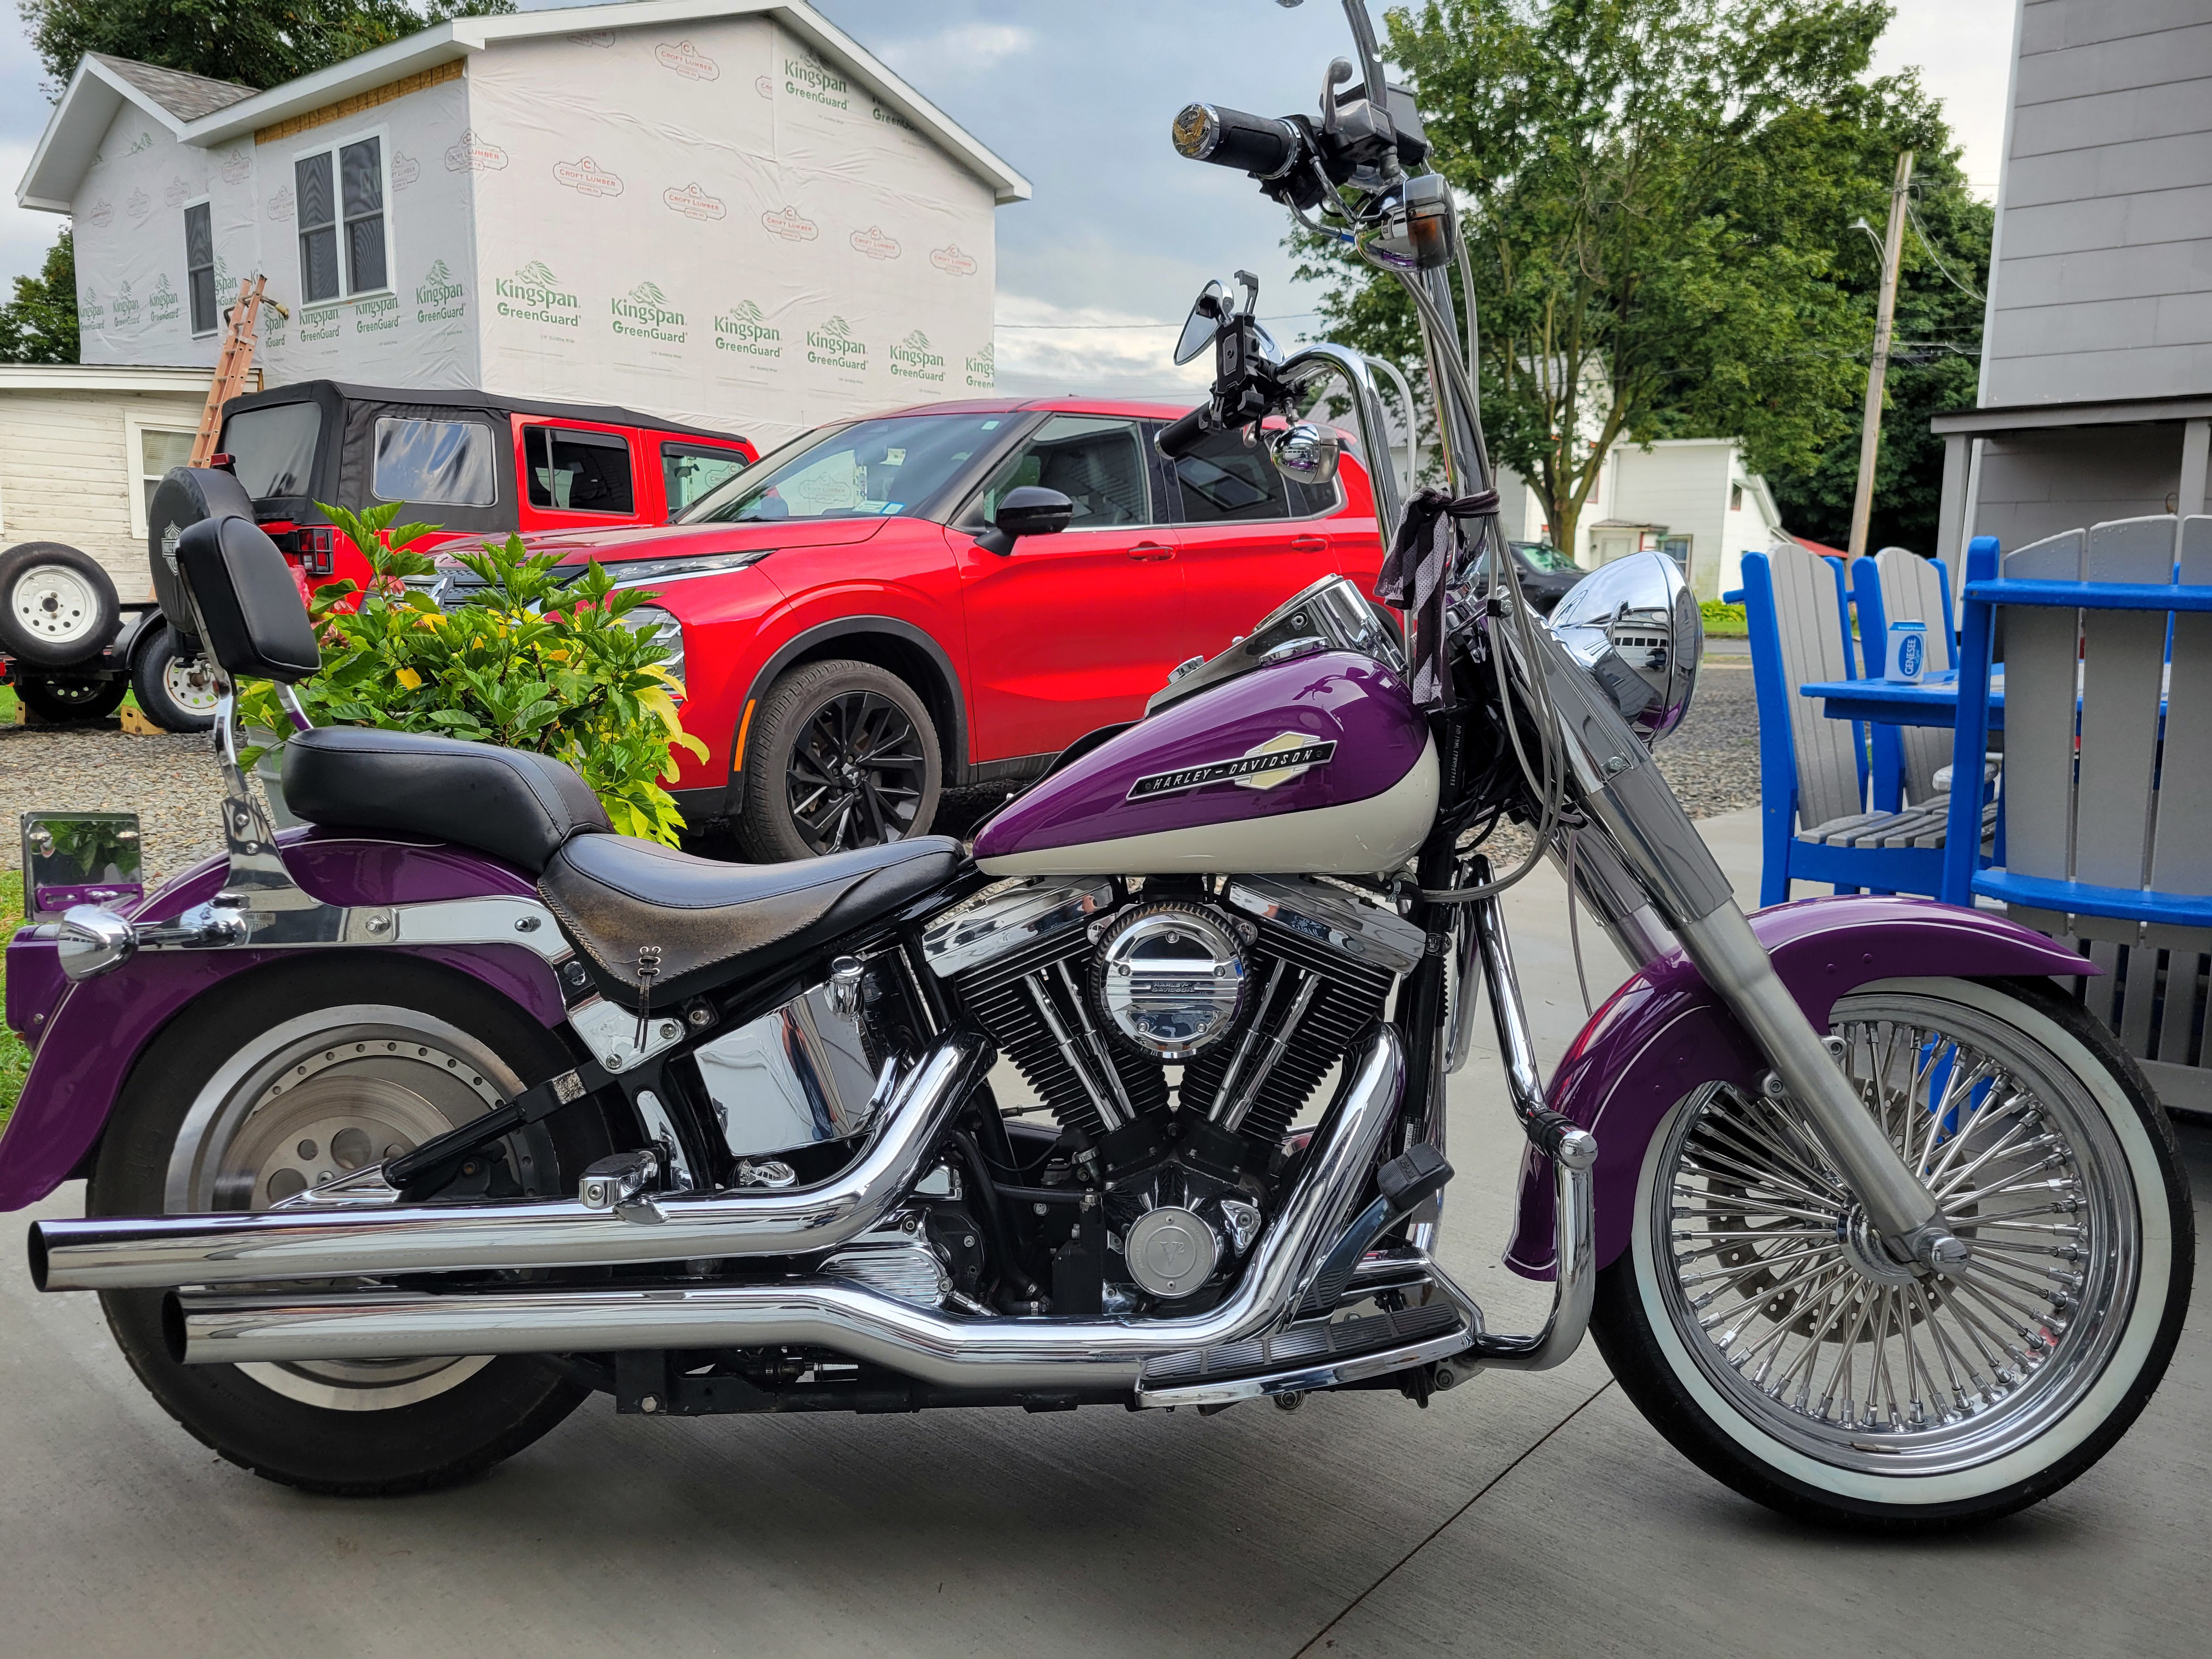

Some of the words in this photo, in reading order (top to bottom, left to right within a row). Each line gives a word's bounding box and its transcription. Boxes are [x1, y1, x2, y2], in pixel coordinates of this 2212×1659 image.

[661, 51, 682, 62] CROFT
[685, 58, 712, 71] LUMBER
[785, 59, 847, 93] Kingspan
[785, 81, 847, 110] GreenGuard
[560, 169, 583, 179] CROFT
[586, 174, 616, 187] LUMBER
[669, 195, 690, 204] CROFT
[693, 200, 719, 211] LUMBER
[149, 293, 178, 310] Kingspan
[416, 284, 463, 307] Kingspan
[496, 278, 579, 309] Kingspan
[79, 305, 104, 320] Kingspan
[112, 300, 139, 315] Kingspan
[151, 308, 179, 321] GreenGuard
[417, 303, 465, 323] GreenGuard
[497, 302, 579, 326] GreenGuard
[611, 298, 685, 326] Kingspan
[301, 325, 340, 342] GreenGuard
[357, 315, 399, 333] GreenGuard
[612, 321, 685, 343] GreenGuard
[714, 315, 780, 342] Kingspan
[715, 337, 780, 357] GreenGuard
[807, 331, 866, 356] Kingspan
[808, 351, 866, 370] GreenGuard
[890, 345, 944, 368] Kingspan
[890, 364, 944, 381] GreenGuard
[1904, 638, 1916, 675] GENESEE
